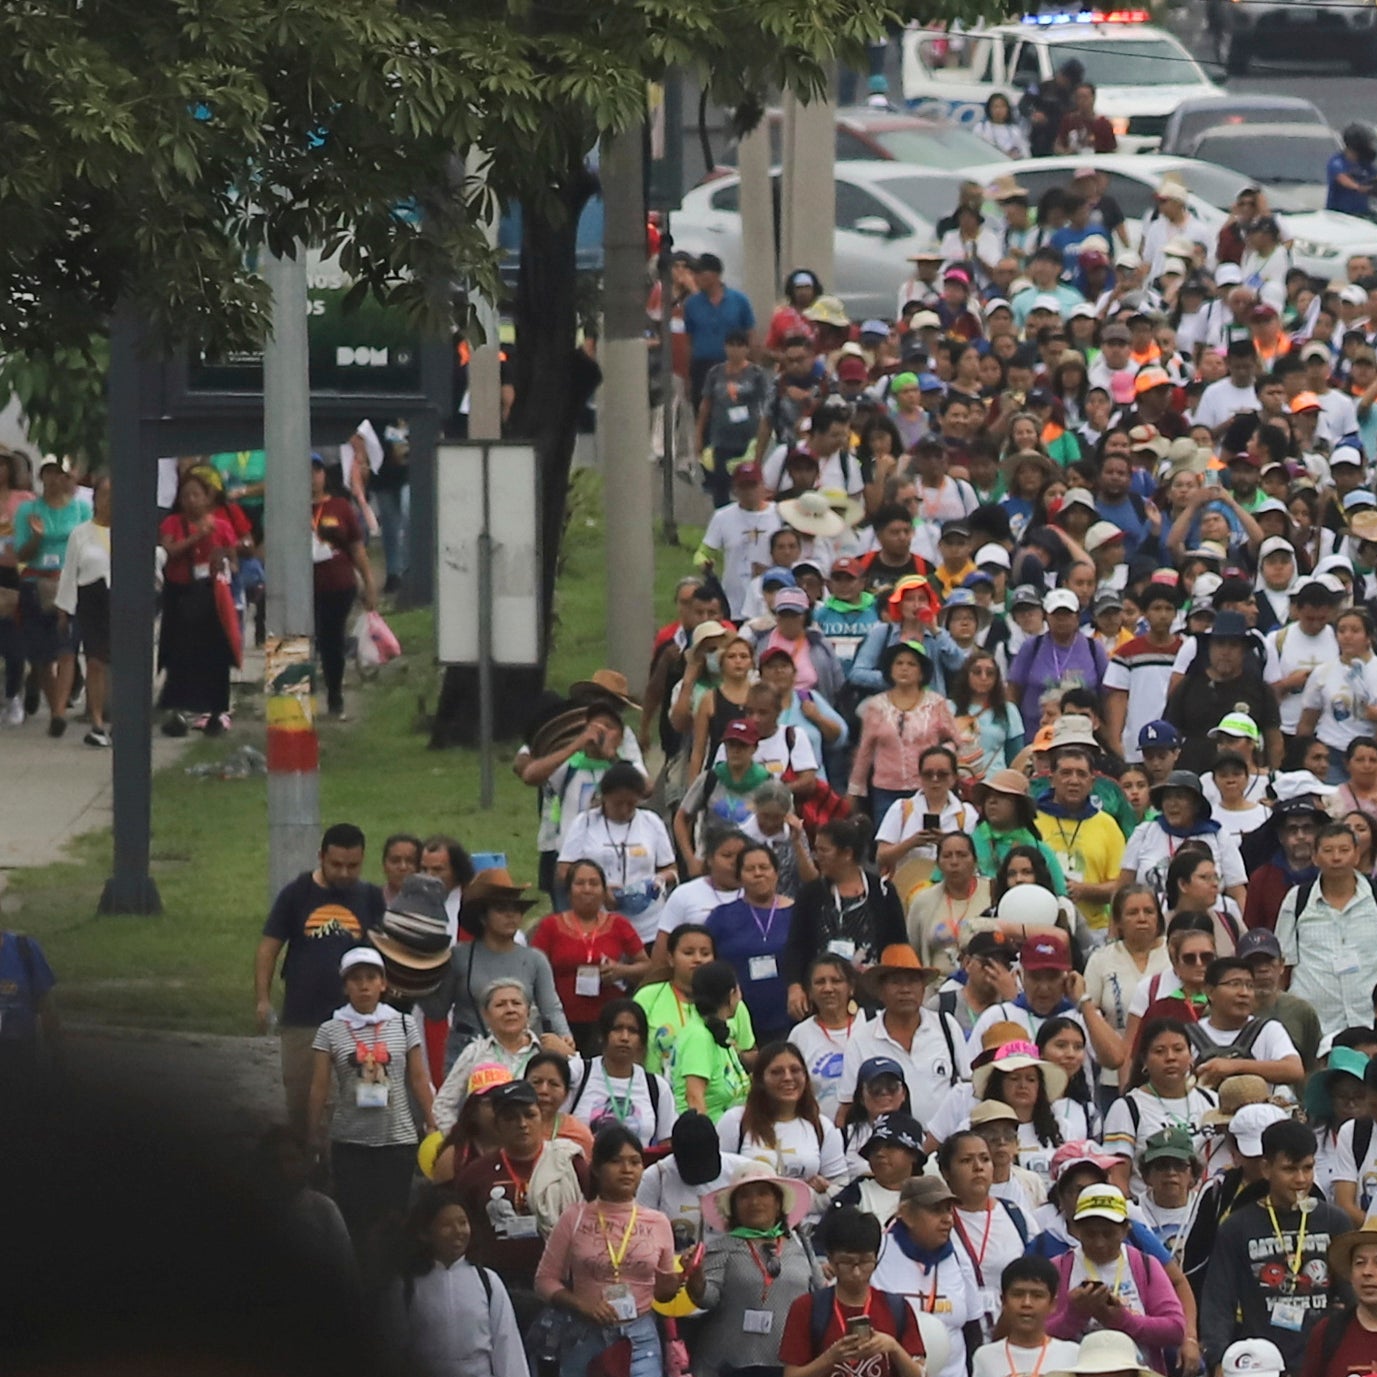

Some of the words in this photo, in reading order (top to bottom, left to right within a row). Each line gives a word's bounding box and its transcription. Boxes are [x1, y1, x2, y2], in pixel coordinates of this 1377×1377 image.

[336, 346, 388, 366] DOM
[823, 622, 875, 634] TOMM
[1248, 1236, 1294, 1259] GATOR
[1312, 1294, 1327, 1309] UP
